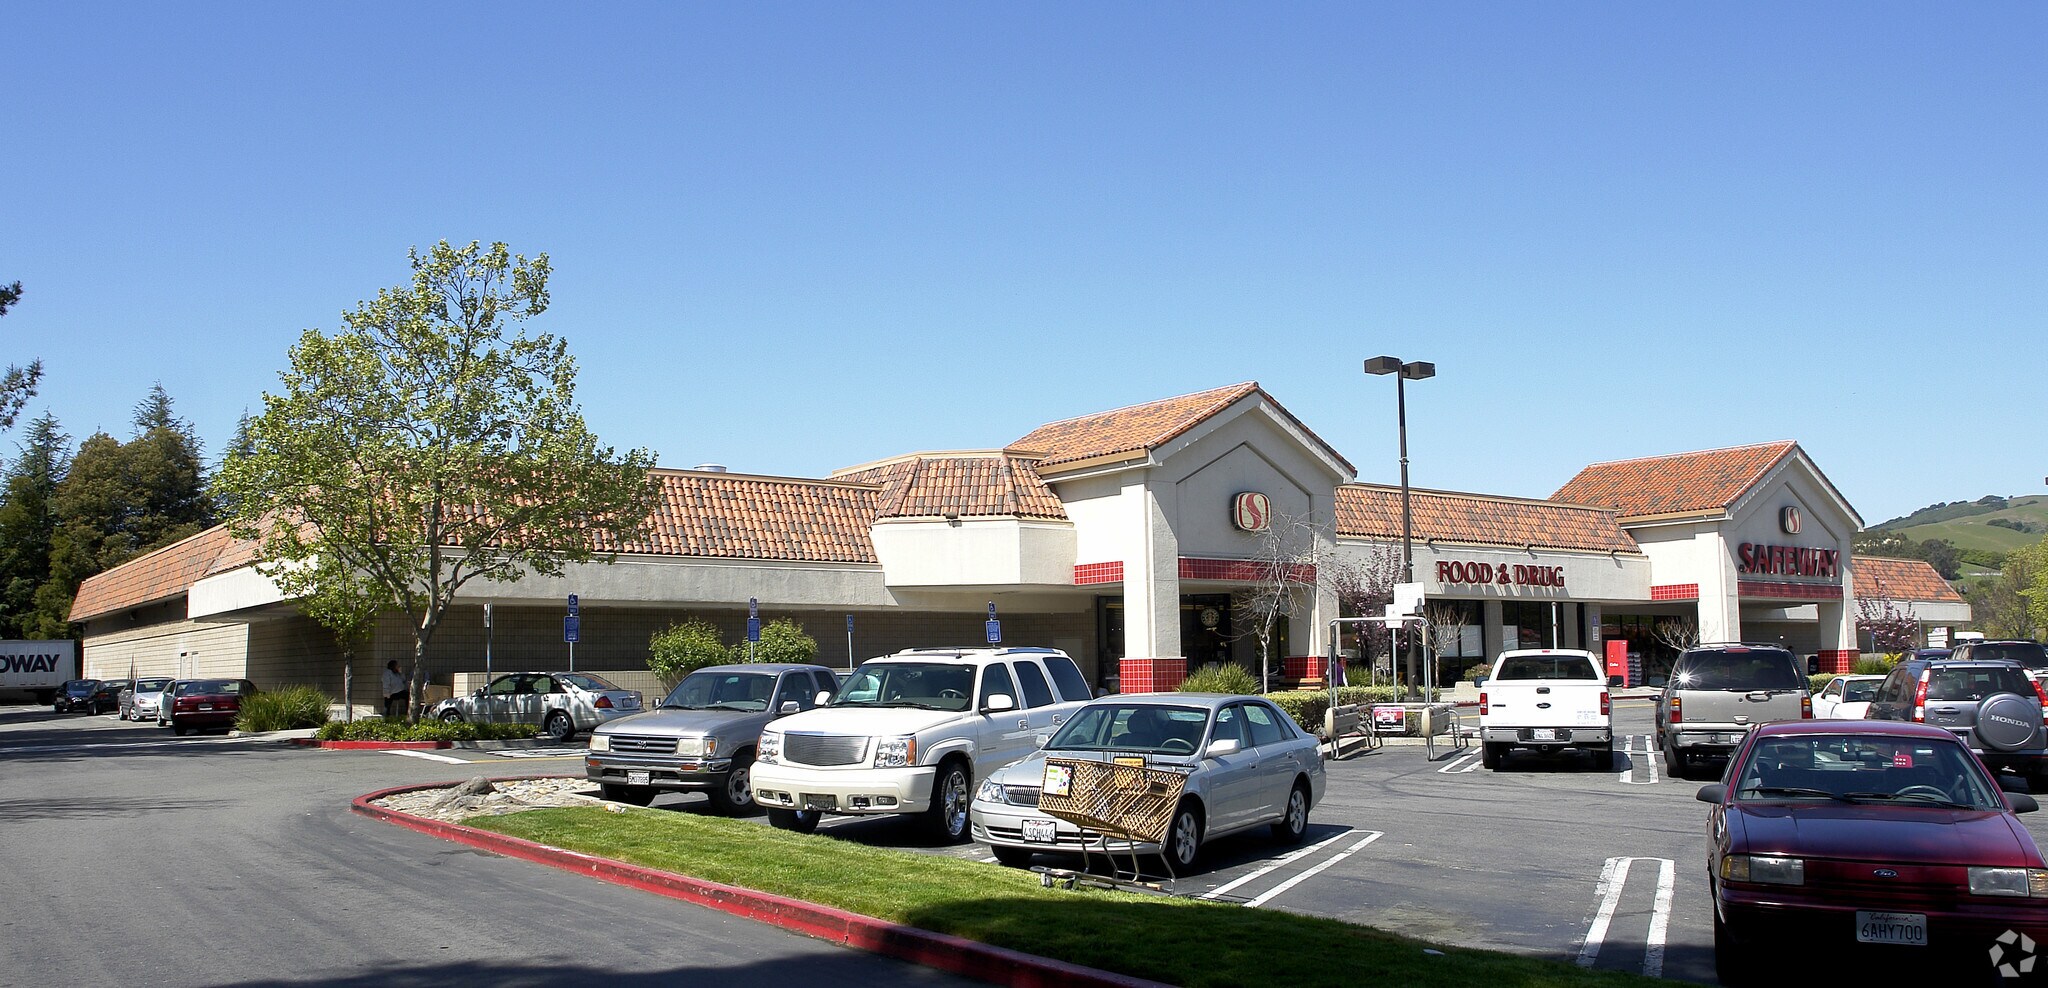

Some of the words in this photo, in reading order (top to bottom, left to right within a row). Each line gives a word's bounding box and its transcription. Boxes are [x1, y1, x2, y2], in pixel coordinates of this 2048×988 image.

[1738, 543, 1840, 577] SAFEWAY
[1436, 561, 1493, 584] FOOD
[1495, 563, 1512, 584] &
[1513, 565, 1565, 587] DRUG
[1990, 714, 2031, 728] HONDA
[1024, 827, 1054, 839] 4SCH446
[1870, 912, 1913, 923] California
[1861, 923, 1922, 940] 6AHY700
